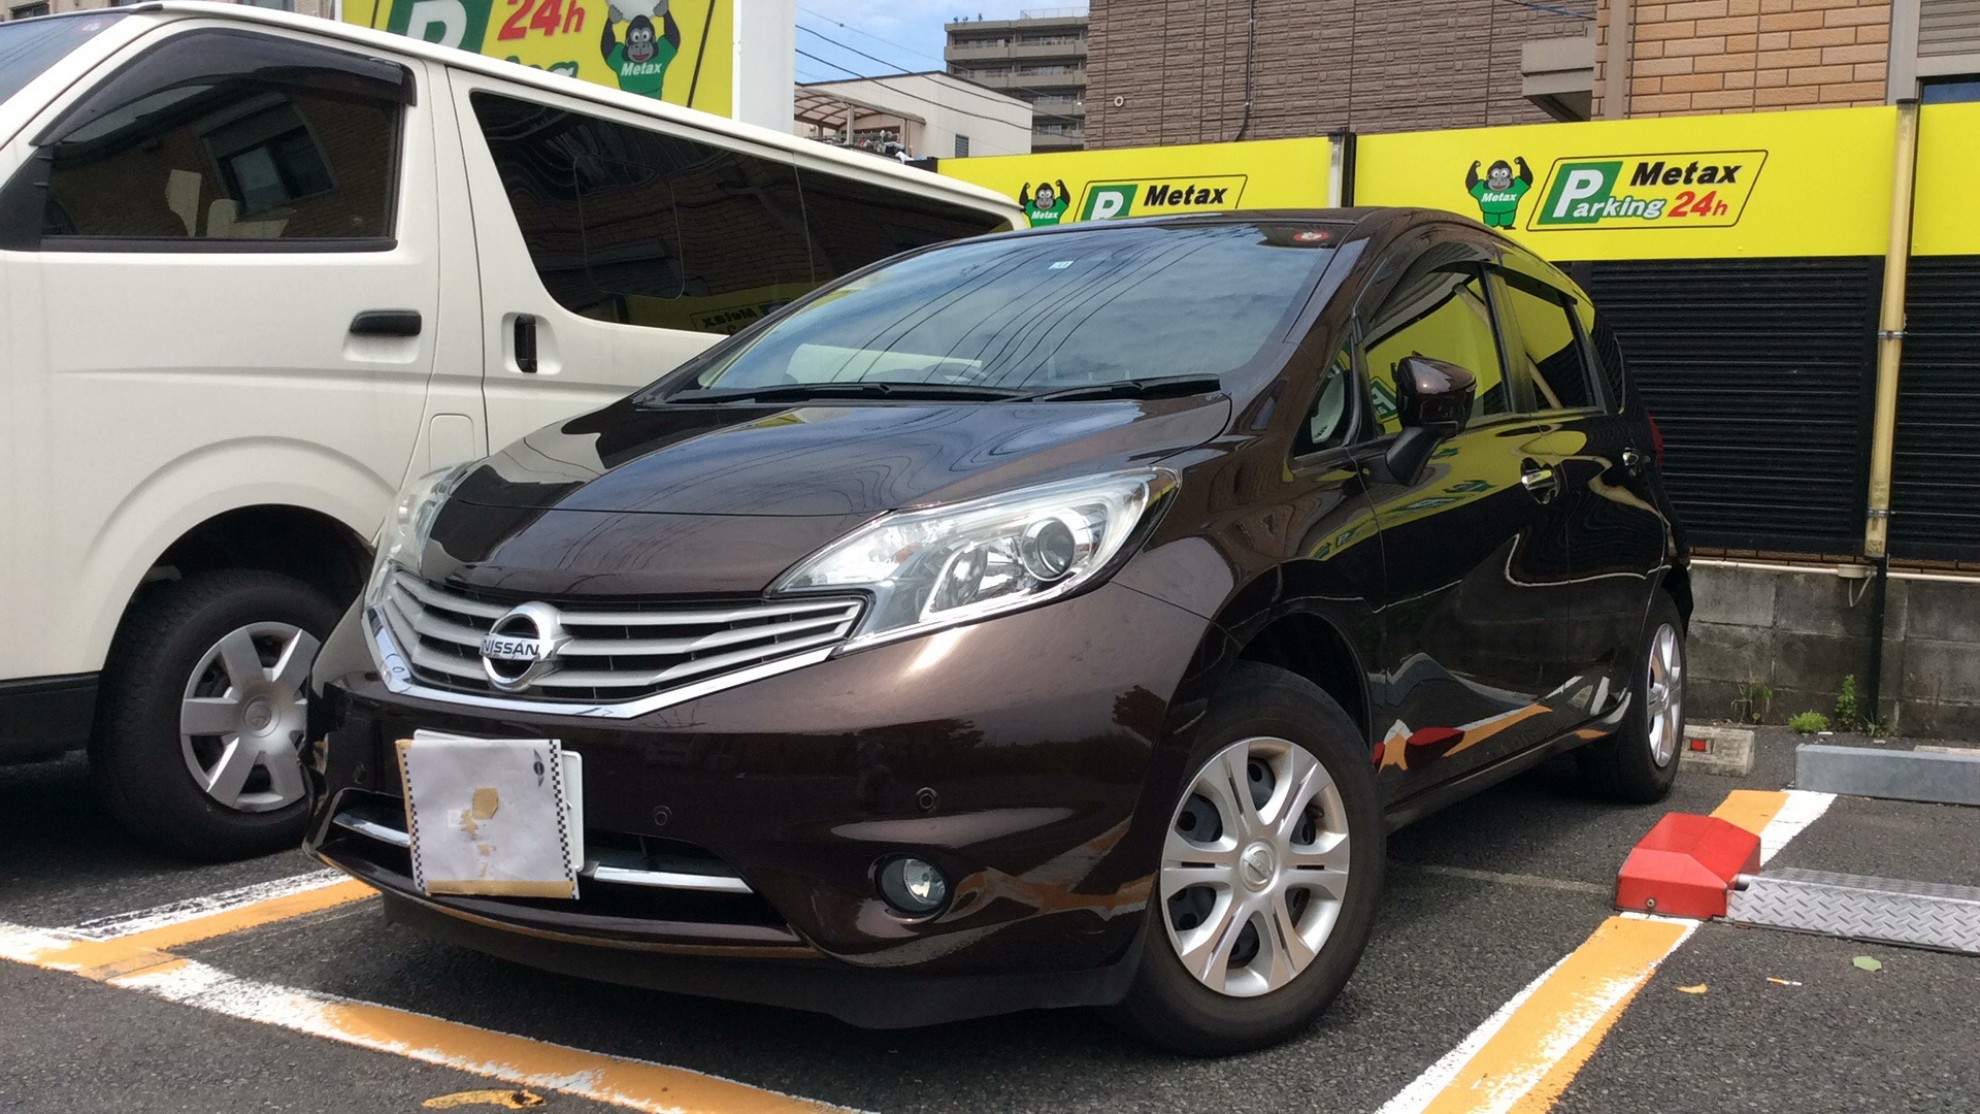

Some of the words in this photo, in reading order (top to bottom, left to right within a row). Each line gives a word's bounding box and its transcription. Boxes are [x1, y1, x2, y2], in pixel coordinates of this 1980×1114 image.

[497, 0, 586, 40] 24h
[620, 62, 662, 77] Metax
[1630, 161, 1743, 186] Metax
[1144, 184, 1227, 206] Metax
[1482, 192, 1517, 202] Metax
[1552, 169, 1665, 219] Parking
[1667, 190, 1728, 217] 24h
[1031, 210, 1058, 219] Metax
[483, 640, 539, 655] NISSAN
